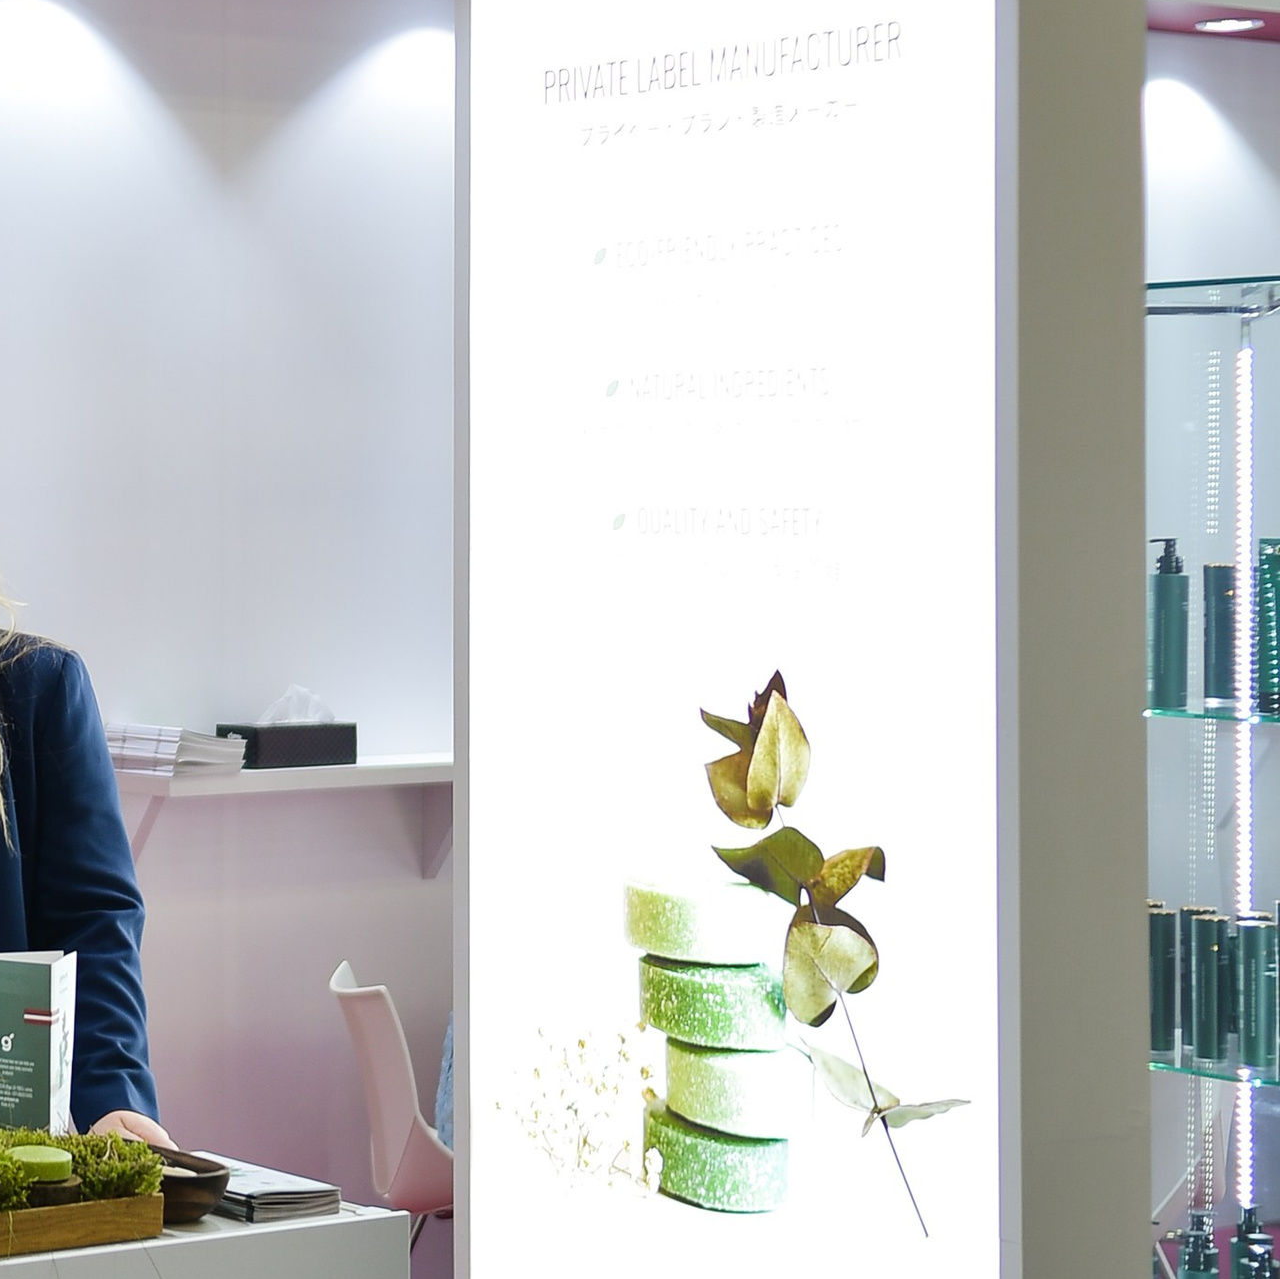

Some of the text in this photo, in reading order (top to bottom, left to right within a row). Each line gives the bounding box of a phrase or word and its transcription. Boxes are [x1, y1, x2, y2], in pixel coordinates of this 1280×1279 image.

[544, 21, 902, 104] PRIVATE LABEL MANUFACTURER
